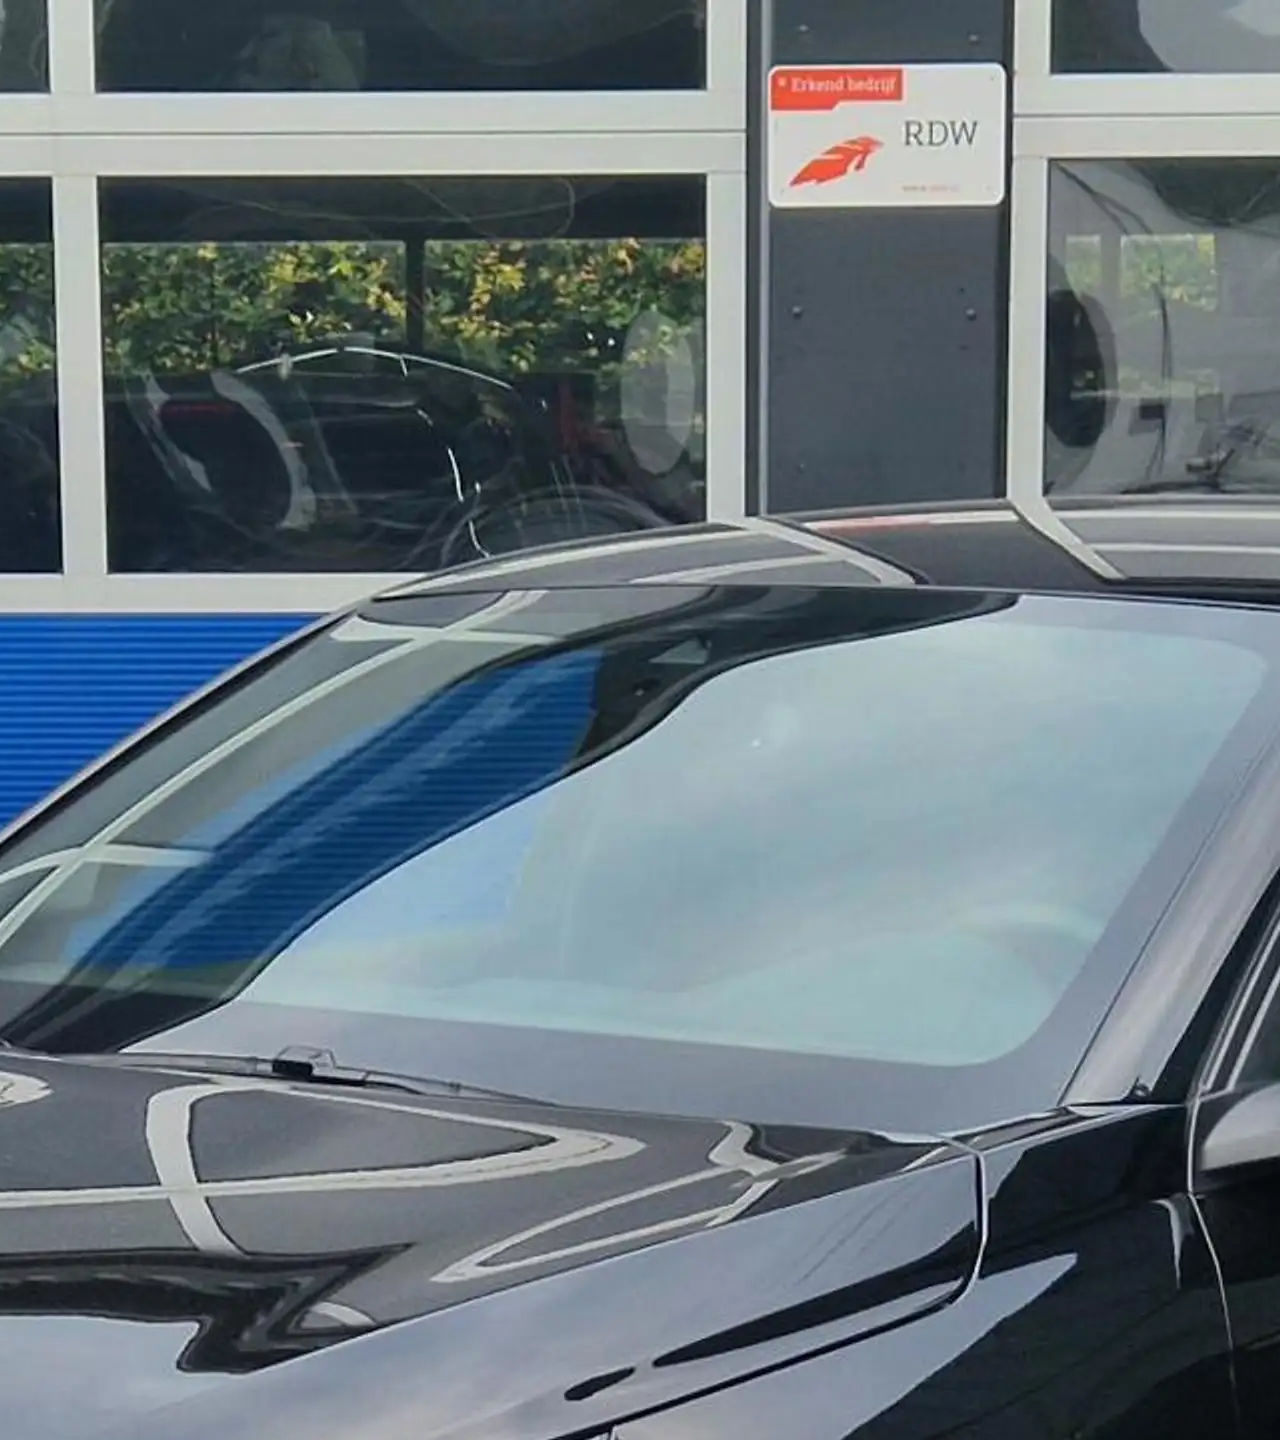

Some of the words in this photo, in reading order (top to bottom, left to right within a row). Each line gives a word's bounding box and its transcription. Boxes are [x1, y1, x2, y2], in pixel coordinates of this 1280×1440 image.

[791, 76, 843, 93] Erkend
[847, 74, 897, 96] bedrijf
[903, 120, 978, 147] RDW
